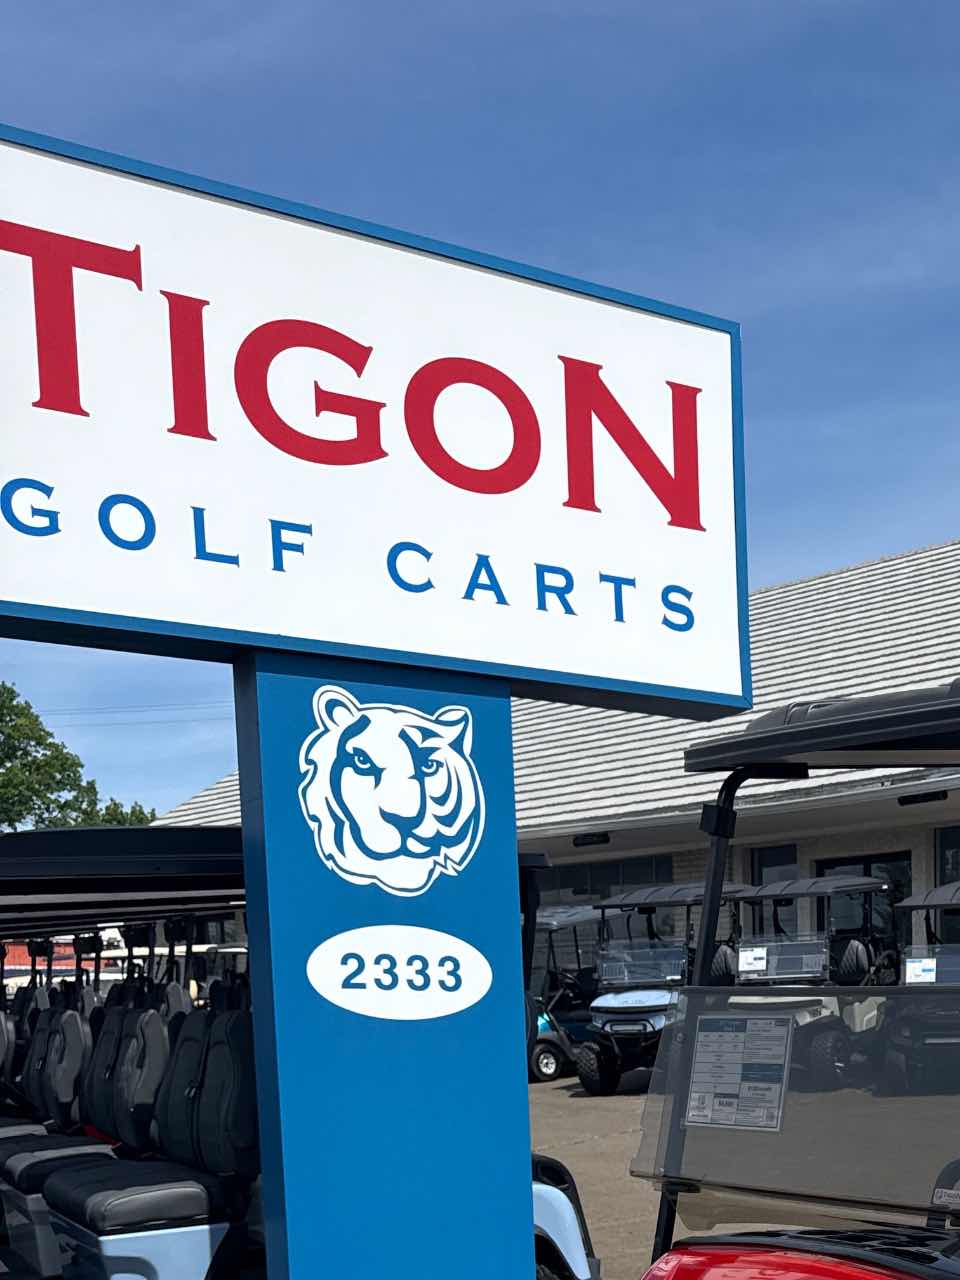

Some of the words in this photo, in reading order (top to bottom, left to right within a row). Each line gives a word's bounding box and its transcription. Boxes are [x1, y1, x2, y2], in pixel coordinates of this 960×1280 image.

[0, 219, 706, 532] TIGON
[0, 477, 313, 572] GOLF
[386, 541, 696, 632] CARTS
[340, 952, 462, 993] 2333
